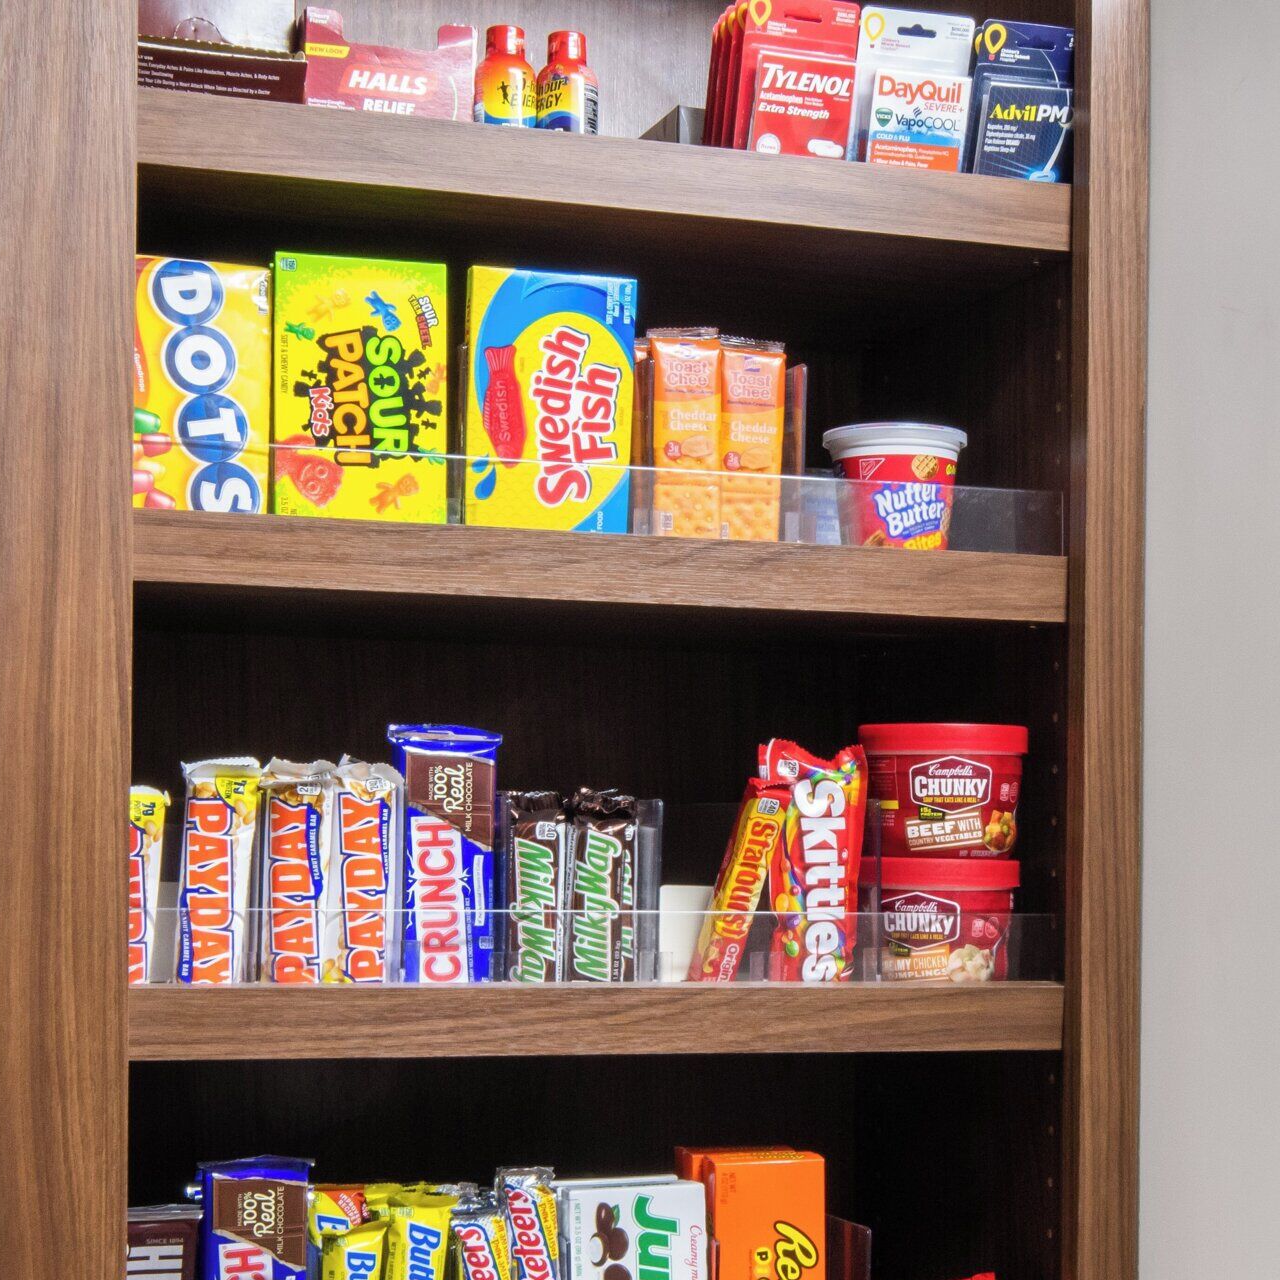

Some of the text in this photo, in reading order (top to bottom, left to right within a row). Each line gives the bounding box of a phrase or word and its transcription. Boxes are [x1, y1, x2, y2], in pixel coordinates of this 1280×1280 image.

[348, 69, 429, 96] HALLS
[762, 63, 851, 97] TYLENOL
[879, 76, 962, 105] DayQuil
[363, 98, 416, 115] RELIEF
[758, 102, 830, 120] Extra Strength
[896, 115, 960, 131] VapoCOOL
[419, 295, 439, 327] SOUR
[665, 361, 708, 375] Toast
[667, 372, 708, 386] Chee
[731, 371, 771, 387] Toast
[161, 271, 256, 513] DOTS
[325, 331, 372, 467] PATCH
[365, 336, 409, 458] SOUR
[730, 384, 770, 399] Chee
[309, 387, 335, 437] Kids
[540, 328, 588, 505] Swedish
[572, 365, 619, 464] Fish
[670, 409, 717, 422] Cheddar
[731, 421, 778, 436] Cheddar
[730, 432, 770, 445] Cheese
[886, 501, 945, 537] Butter
[433, 765, 448, 801] 100%
[465, 762, 473, 812] CHOCOLATE
[914, 775, 988, 798] CHUNKY
[929, 763, 974, 778] Campbell's
[443, 764, 466, 813] Real
[907, 818, 982, 838] BEEF WITH
[909, 831, 983, 846] COUNTRY VEGETABLES
[187, 800, 231, 982] PAYDAY
[272, 799, 319, 982] PAYDAY
[342, 794, 385, 982] PAYDAY
[723, 820, 779, 935] Starburst
[793, 779, 847, 982] Skittles
[416, 822, 462, 983] CRUNCH
[894, 899, 938, 912] Campbell's
[884, 911, 955, 935] CHUNKY
[183, 934, 191, 964] CARAMEL
[913, 954, 949, 970] CHICKEN
[243, 1191, 257, 1227] 100%
[254, 1189, 275, 1239] Real
[276, 1185, 285, 1255] MILK CHOCOLATE
[686, 1224, 703, 1268] Creamy
